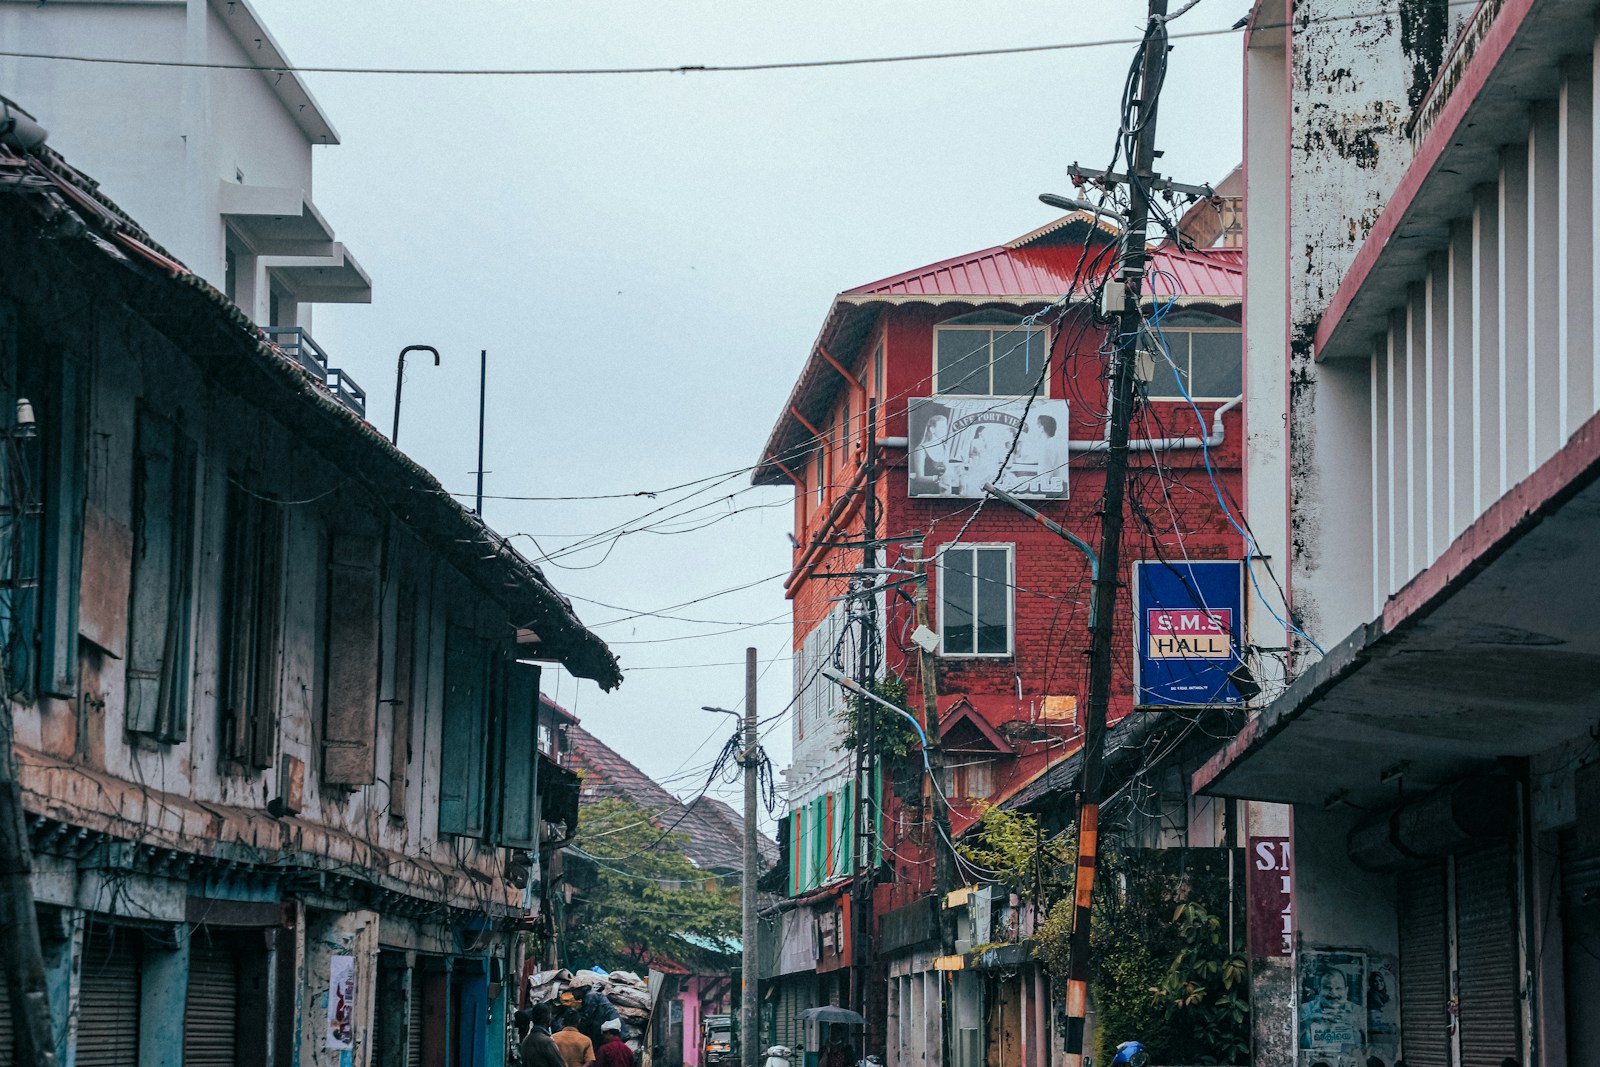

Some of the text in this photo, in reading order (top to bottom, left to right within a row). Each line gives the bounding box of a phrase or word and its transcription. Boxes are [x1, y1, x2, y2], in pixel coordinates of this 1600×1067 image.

[952, 415, 975, 430] CAFE
[977, 412, 1001, 422] PORT
[1158, 614, 1223, 631] S.M.S
[1158, 638, 1222, 653] HALL
